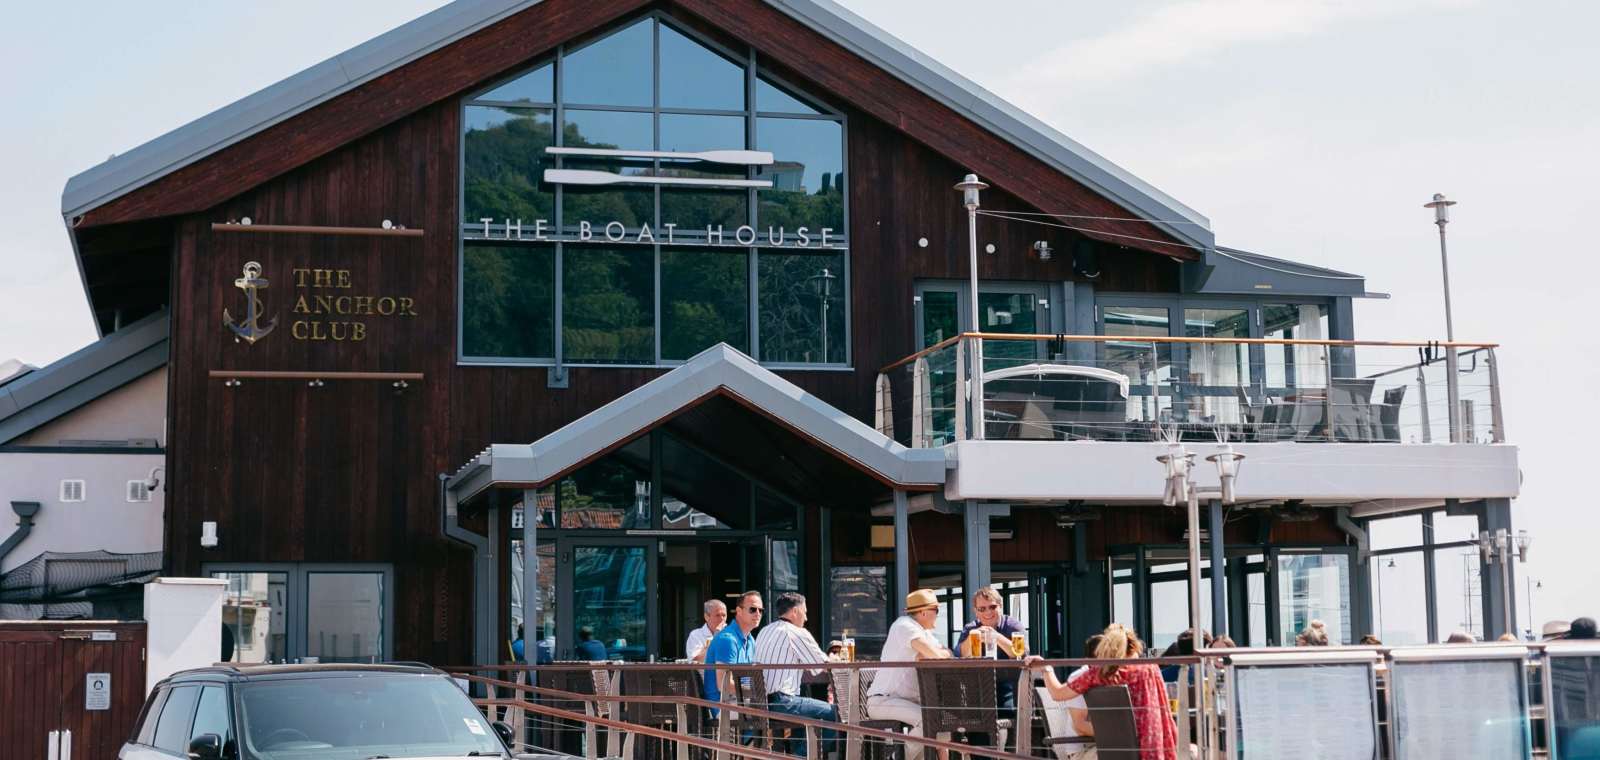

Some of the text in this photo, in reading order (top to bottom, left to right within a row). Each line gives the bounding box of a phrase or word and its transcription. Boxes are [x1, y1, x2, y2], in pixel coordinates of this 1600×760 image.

[480, 218, 835, 248] THE BOAT HOUSE
[293, 268, 352, 288] THE
[292, 295, 418, 316] ANCHOR
[292, 320, 367, 341] CLUB
